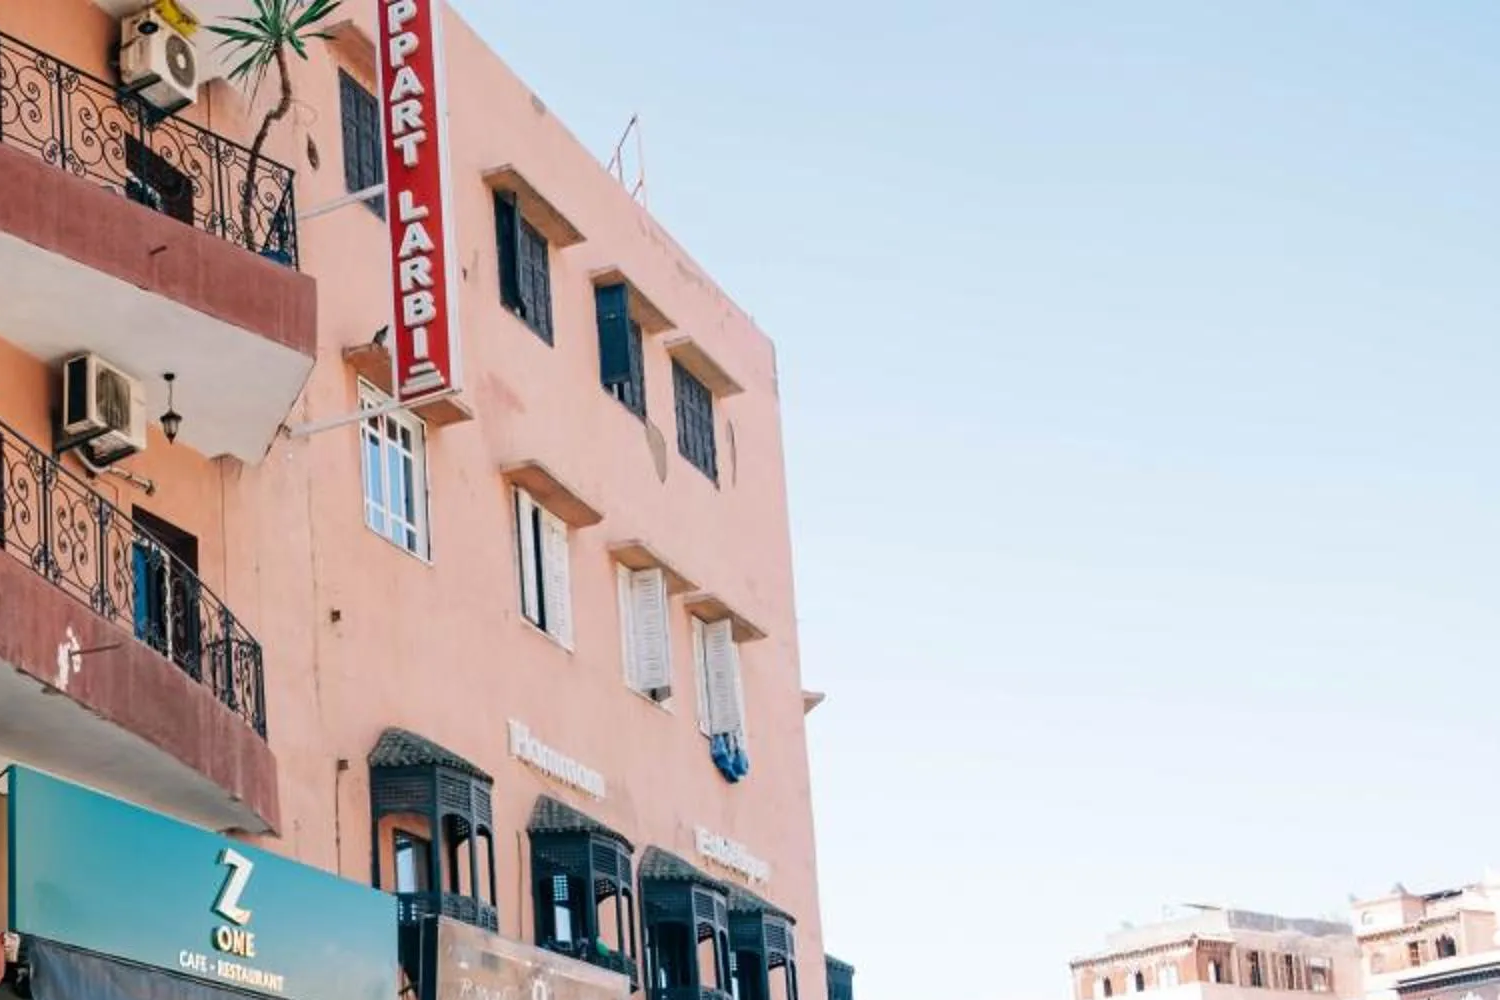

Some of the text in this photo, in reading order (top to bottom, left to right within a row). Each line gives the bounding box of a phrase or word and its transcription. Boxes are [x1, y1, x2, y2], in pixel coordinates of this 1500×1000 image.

[384, 0, 437, 360] PPART LARBI
[212, 848, 256, 926] Z
[214, 925, 256, 958] ONE
[217, 959, 285, 993] RESTAURANT
